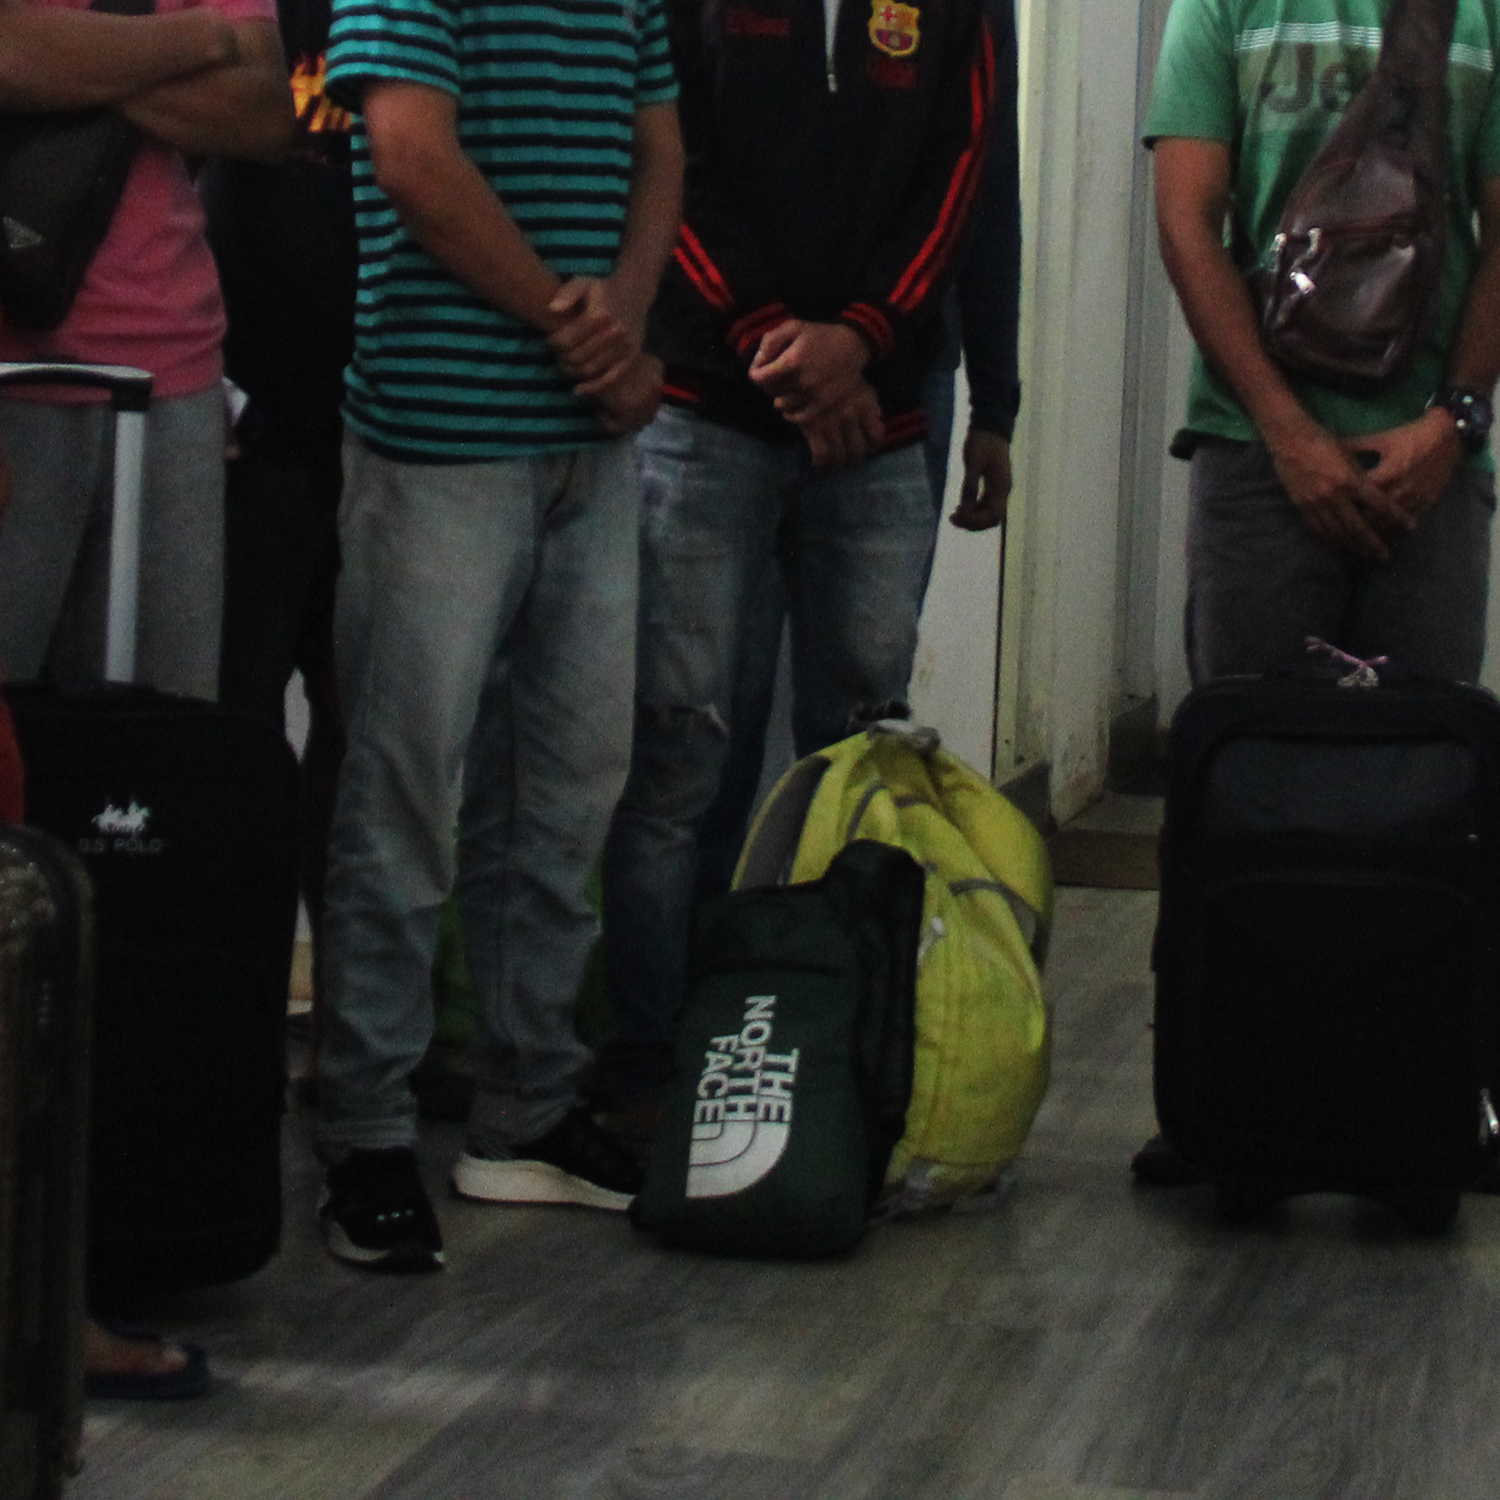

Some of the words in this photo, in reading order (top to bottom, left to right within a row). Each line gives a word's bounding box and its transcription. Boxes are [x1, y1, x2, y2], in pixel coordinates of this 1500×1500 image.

[113, 837, 165, 853] POLO
[693, 1033, 740, 1122] FACE
[724, 994, 779, 1122] NORTH
[756, 1047, 800, 1122] THE
